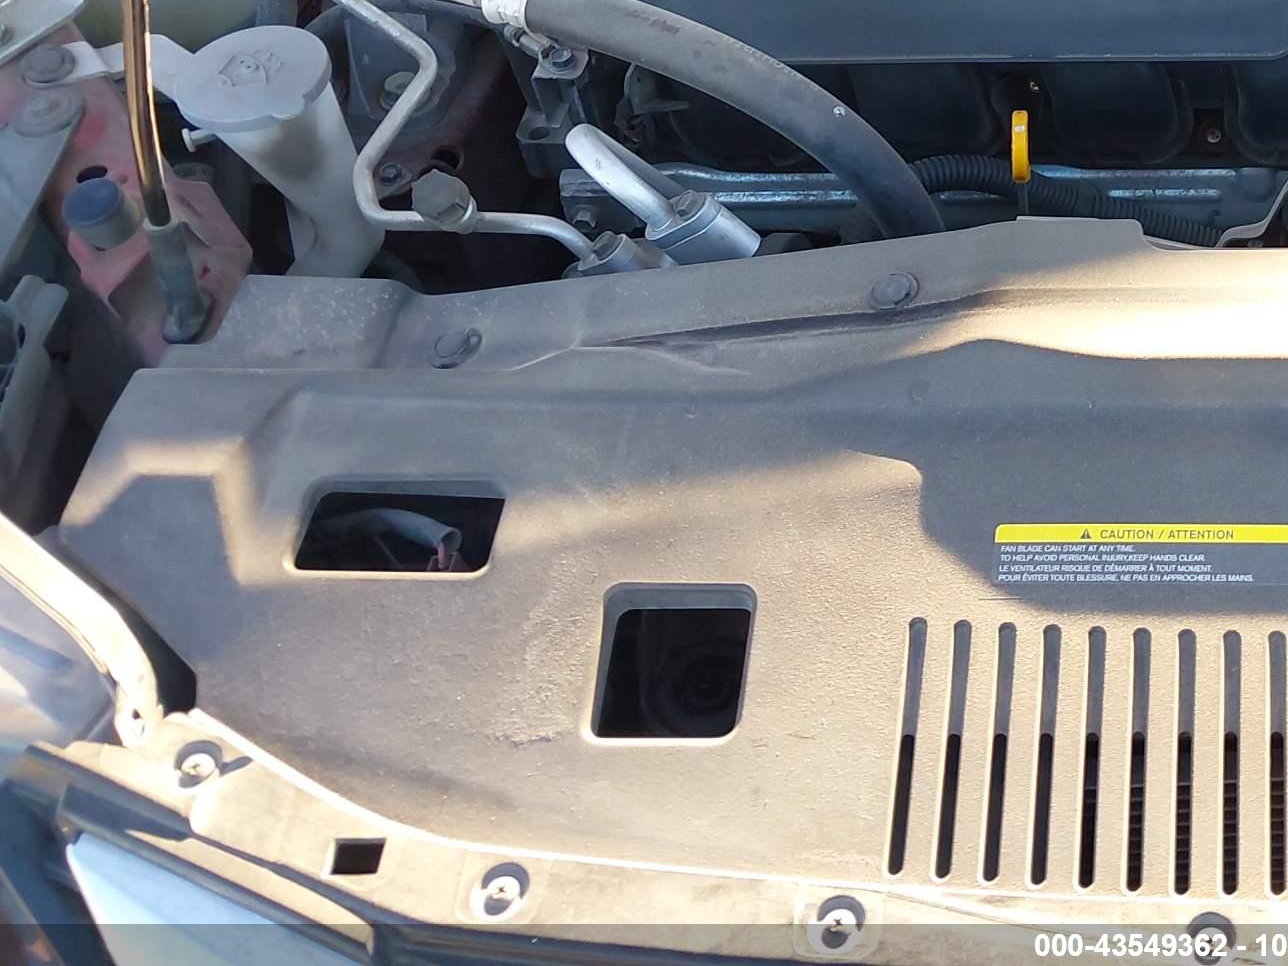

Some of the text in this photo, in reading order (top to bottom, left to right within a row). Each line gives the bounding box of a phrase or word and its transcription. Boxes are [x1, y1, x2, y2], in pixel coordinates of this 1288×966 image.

[1100, 529, 1154, 539] CAUTION
[1168, 529, 1234, 539] ATTENTION
[999, 564, 1010, 572] LE
[1010, 564, 1060, 572] VENTILATEUR
[1061, 564, 1091, 572] RISQUE
[1092, 564, 1103, 572] DE
[1104, 563, 1148, 572] DÉMARRER
[1155, 564, 1176, 572] TOUT
[1022, 572, 1049, 581] ÉVITER
